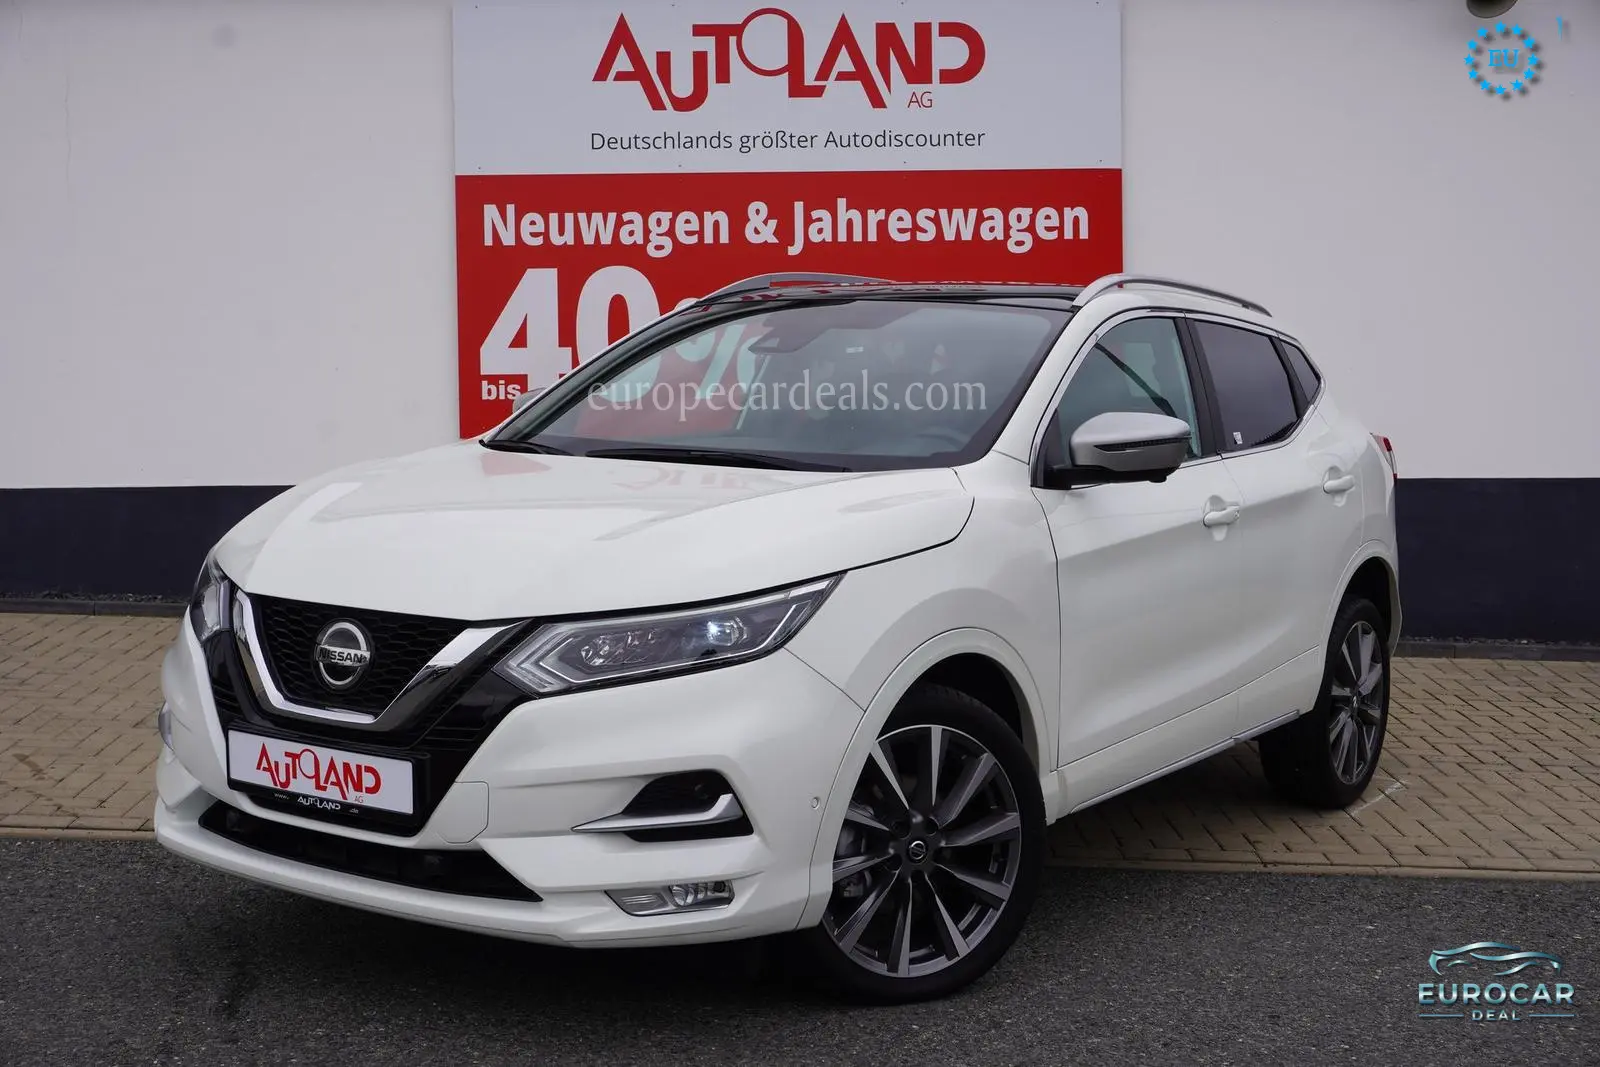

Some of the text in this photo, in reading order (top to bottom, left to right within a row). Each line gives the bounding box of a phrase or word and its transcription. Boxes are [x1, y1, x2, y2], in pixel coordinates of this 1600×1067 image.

[592, 7, 986, 112] AUTOLAND
[907, 91, 933, 108] AG
[590, 129, 985, 154] Deutschlands größter Autodiscounter
[482, 197, 1089, 258] Neuwagen & Jahreswagen
[481, 379, 521, 401] bis
[319, 647, 363, 664] NISSAN
[256, 742, 382, 801] AUTOLAND
